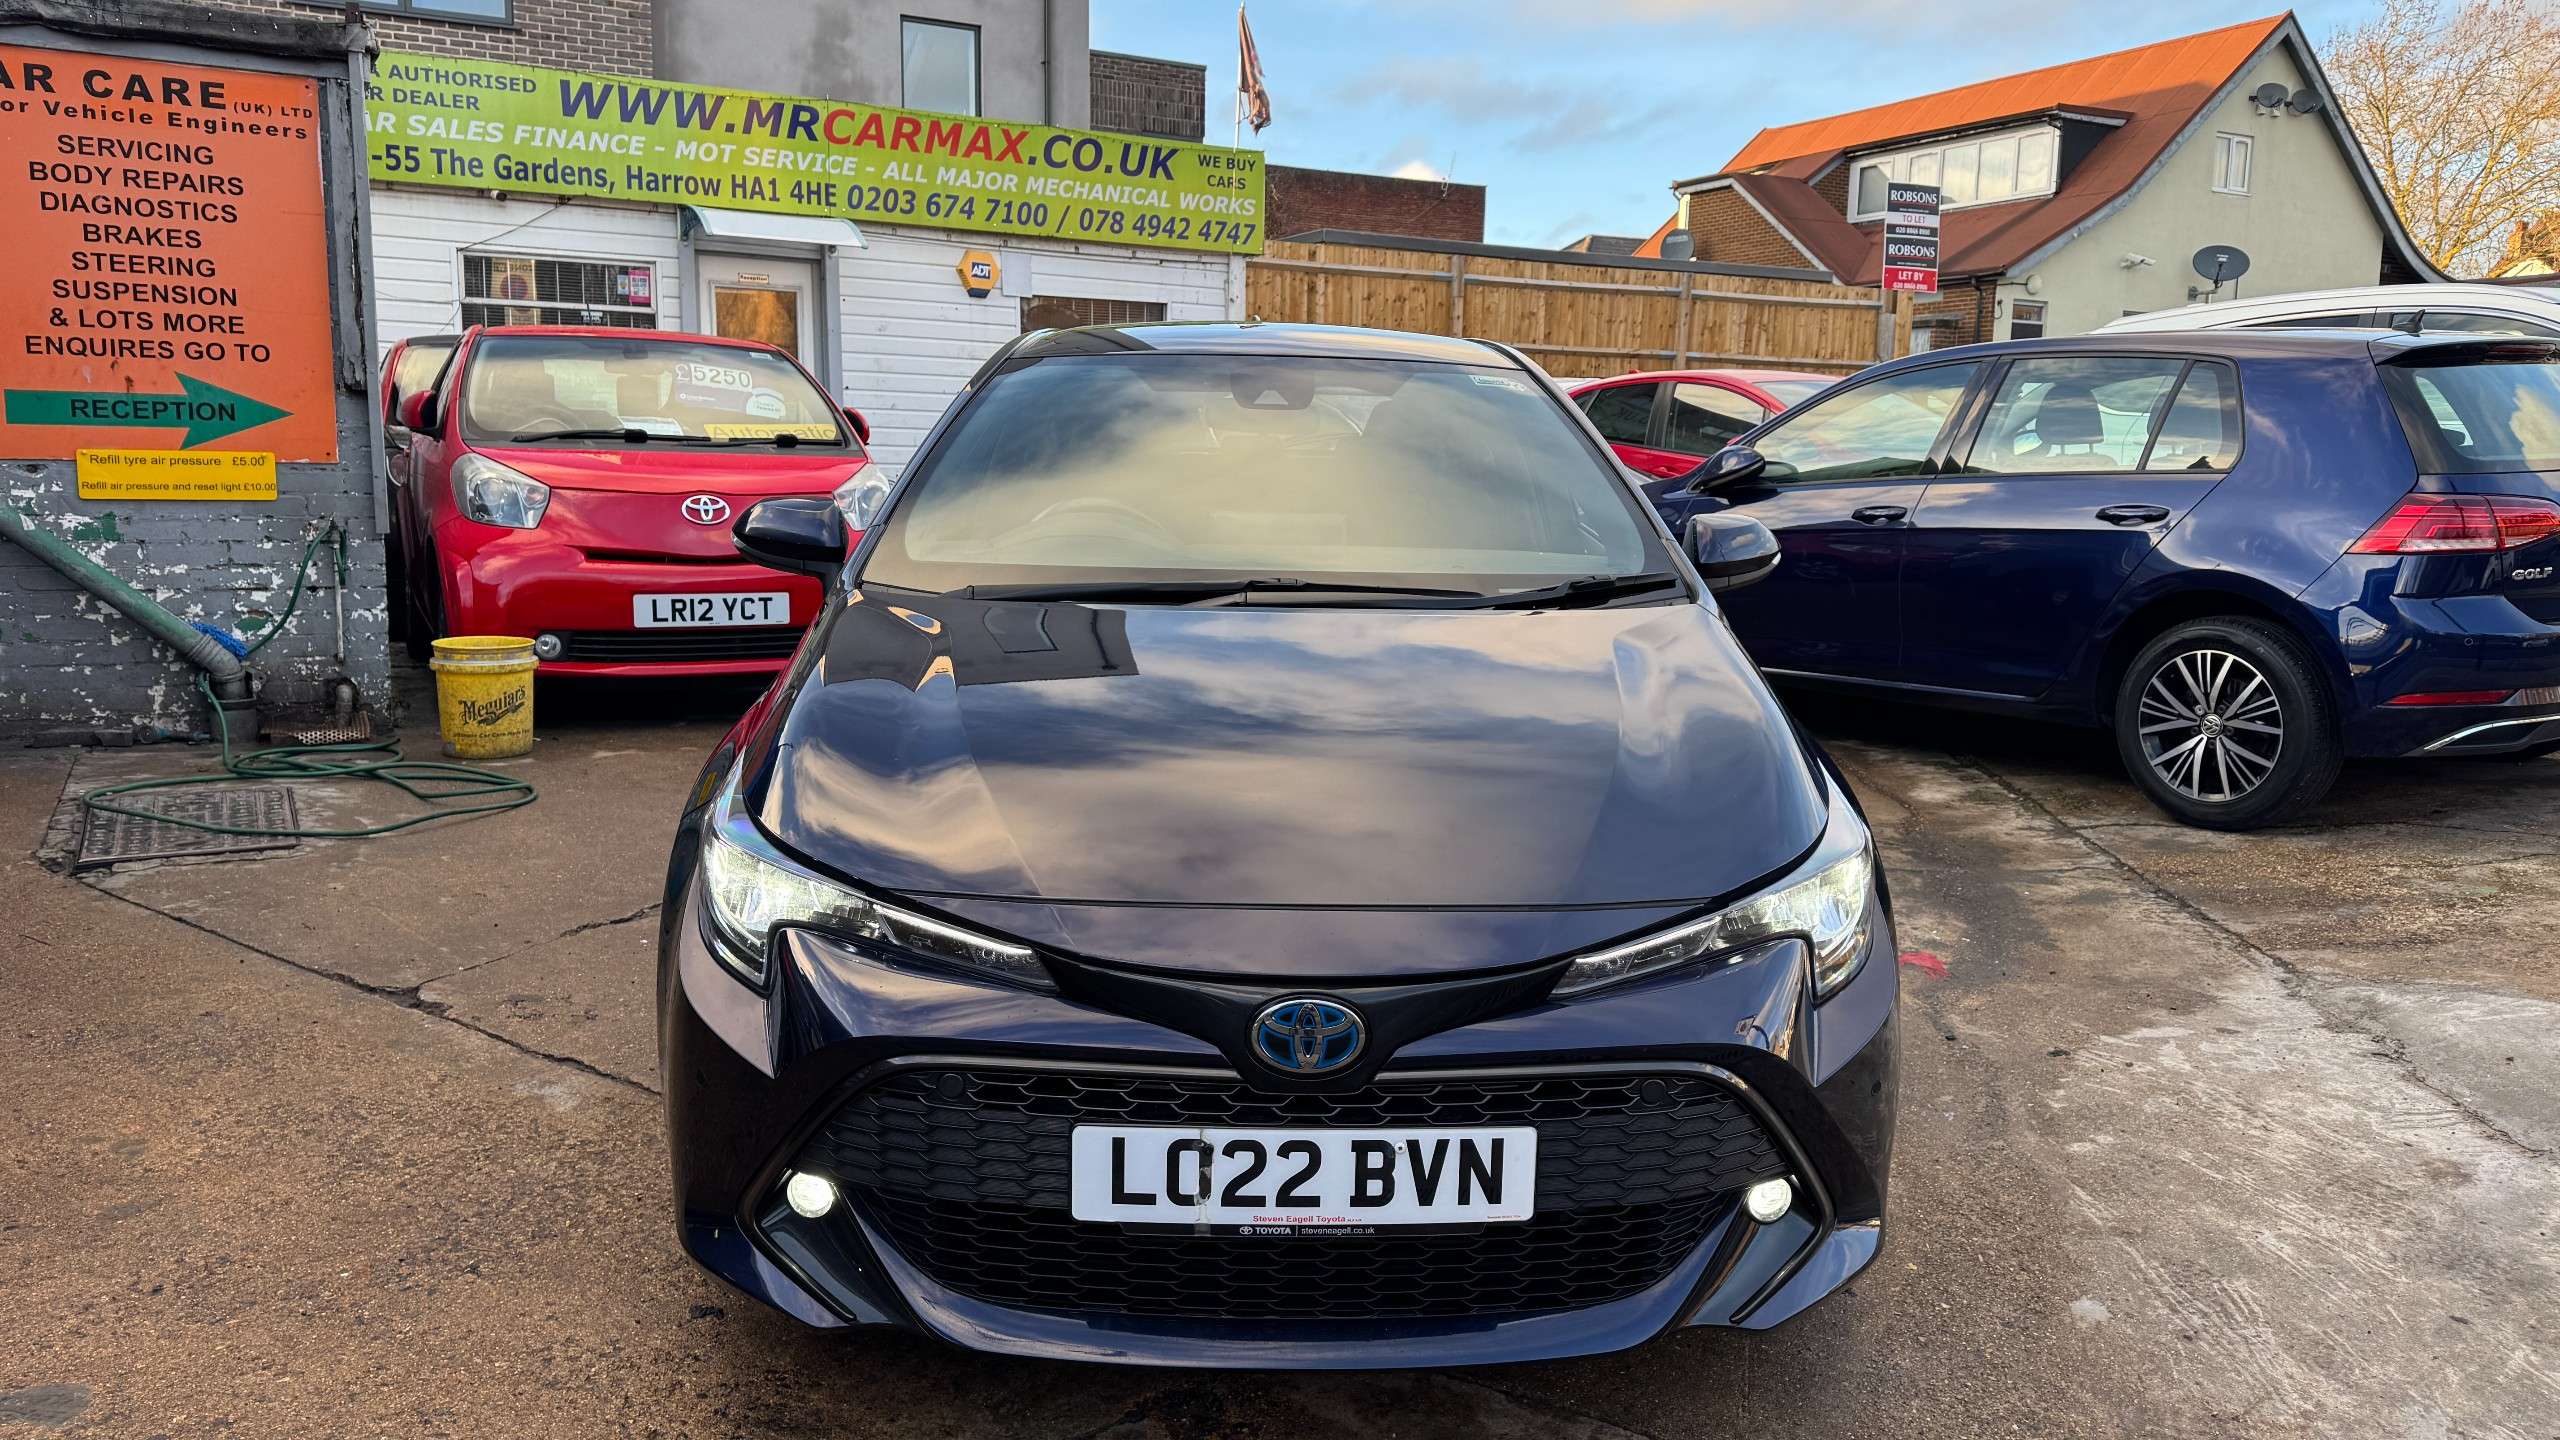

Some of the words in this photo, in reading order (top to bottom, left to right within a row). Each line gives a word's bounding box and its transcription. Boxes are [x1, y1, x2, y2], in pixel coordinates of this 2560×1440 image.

[388, 64, 537, 93] AUTHORISED
[82, 69, 226, 110] CARE
[233, 102, 273, 116] (UK)
[281, 107, 313, 119] LTD
[393, 87, 480, 111] DEALER
[43, 100, 153, 125] Vehicle
[168, 111, 308, 140] Engineers
[559, 78, 1180, 181] WWW.MRCARMAX.CO.UK
[57, 135, 214, 165] SERVICING
[406, 114, 504, 143] SALES
[514, 125, 646, 156] FINANCE
[674, 139, 736, 163] MOT
[743, 147, 858, 176] SERVICE
[882, 161, 927, 183] ALL
[936, 166, 1017, 192] MAJOR
[1025, 176, 1171, 208] MECHANICAL
[1179, 192, 1256, 216] WORKS
[1198, 153, 1221, 169] WE
[1226, 156, 1256, 173] BUY
[29, 161, 112, 186] BODY
[123, 168, 244, 195] REPAIRS
[1207, 174, 1246, 190] CARS
[40, 191, 238, 224] DIAGNOSTICS
[431, 148, 483, 178] The
[493, 153, 615, 194] Gardens,
[626, 165, 721, 197] Harrow
[731, 173, 780, 202] HA1
[789, 180, 837, 207] 4HE
[848, 184, 916, 213] 0203
[925, 192, 975, 220] 674
[984, 198, 1048, 227] 7100
[1079, 207, 1125, 234] 078
[1132, 213, 1191, 240] 4942
[1198, 219, 1256, 245] 4747
[1890, 189, 1938, 204] ROBSONS
[1903, 214, 1912, 223] TO
[1914, 215, 1926, 224] LET
[83, 224, 201, 249] BRAKES
[1888, 243, 1936, 258] ROBSONS
[71, 252, 216, 278] STEERING
[971, 263, 992, 277] ADT
[1898, 270, 1912, 280] LET
[1913, 271, 1925, 281] BY
[53, 279, 237, 307] SUSPENSION
[49, 308, 68, 327] &
[79, 309, 153, 332] LOTS
[163, 312, 244, 335] MORE
[25, 335, 174, 360] ENQUIRES
[184, 341, 226, 361] GO
[235, 343, 270, 362] TO
[71, 398, 236, 422] RECEPTION
[90, 454, 120, 465] Refill
[124, 456, 146, 467] tyre
[151, 455, 165, 465] air
[169, 456, 221, 467] pressure
[232, 456, 265, 466] £5.00
[82, 481, 107, 490] Refill
[110, 482, 122, 490] air
[126, 482, 169, 492] pressure
[172, 482, 191, 491] and
[193, 482, 218, 491] reset
[221, 482, 241, 492] light
[243, 482, 276, 492] £10.00
[2512, 567, 2553, 580] GOLF
[652, 598, 713, 622] LR12
[722, 597, 773, 620] YCT
[1350, 1137, 1505, 1208] BVN
[1252, 1215, 1283, 1223] Steven
[1286, 1215, 1314, 1224] Eagell
[1317, 1215, 1346, 1224] Toyota
[1255, 1227, 1292, 1235] TOYOTA
